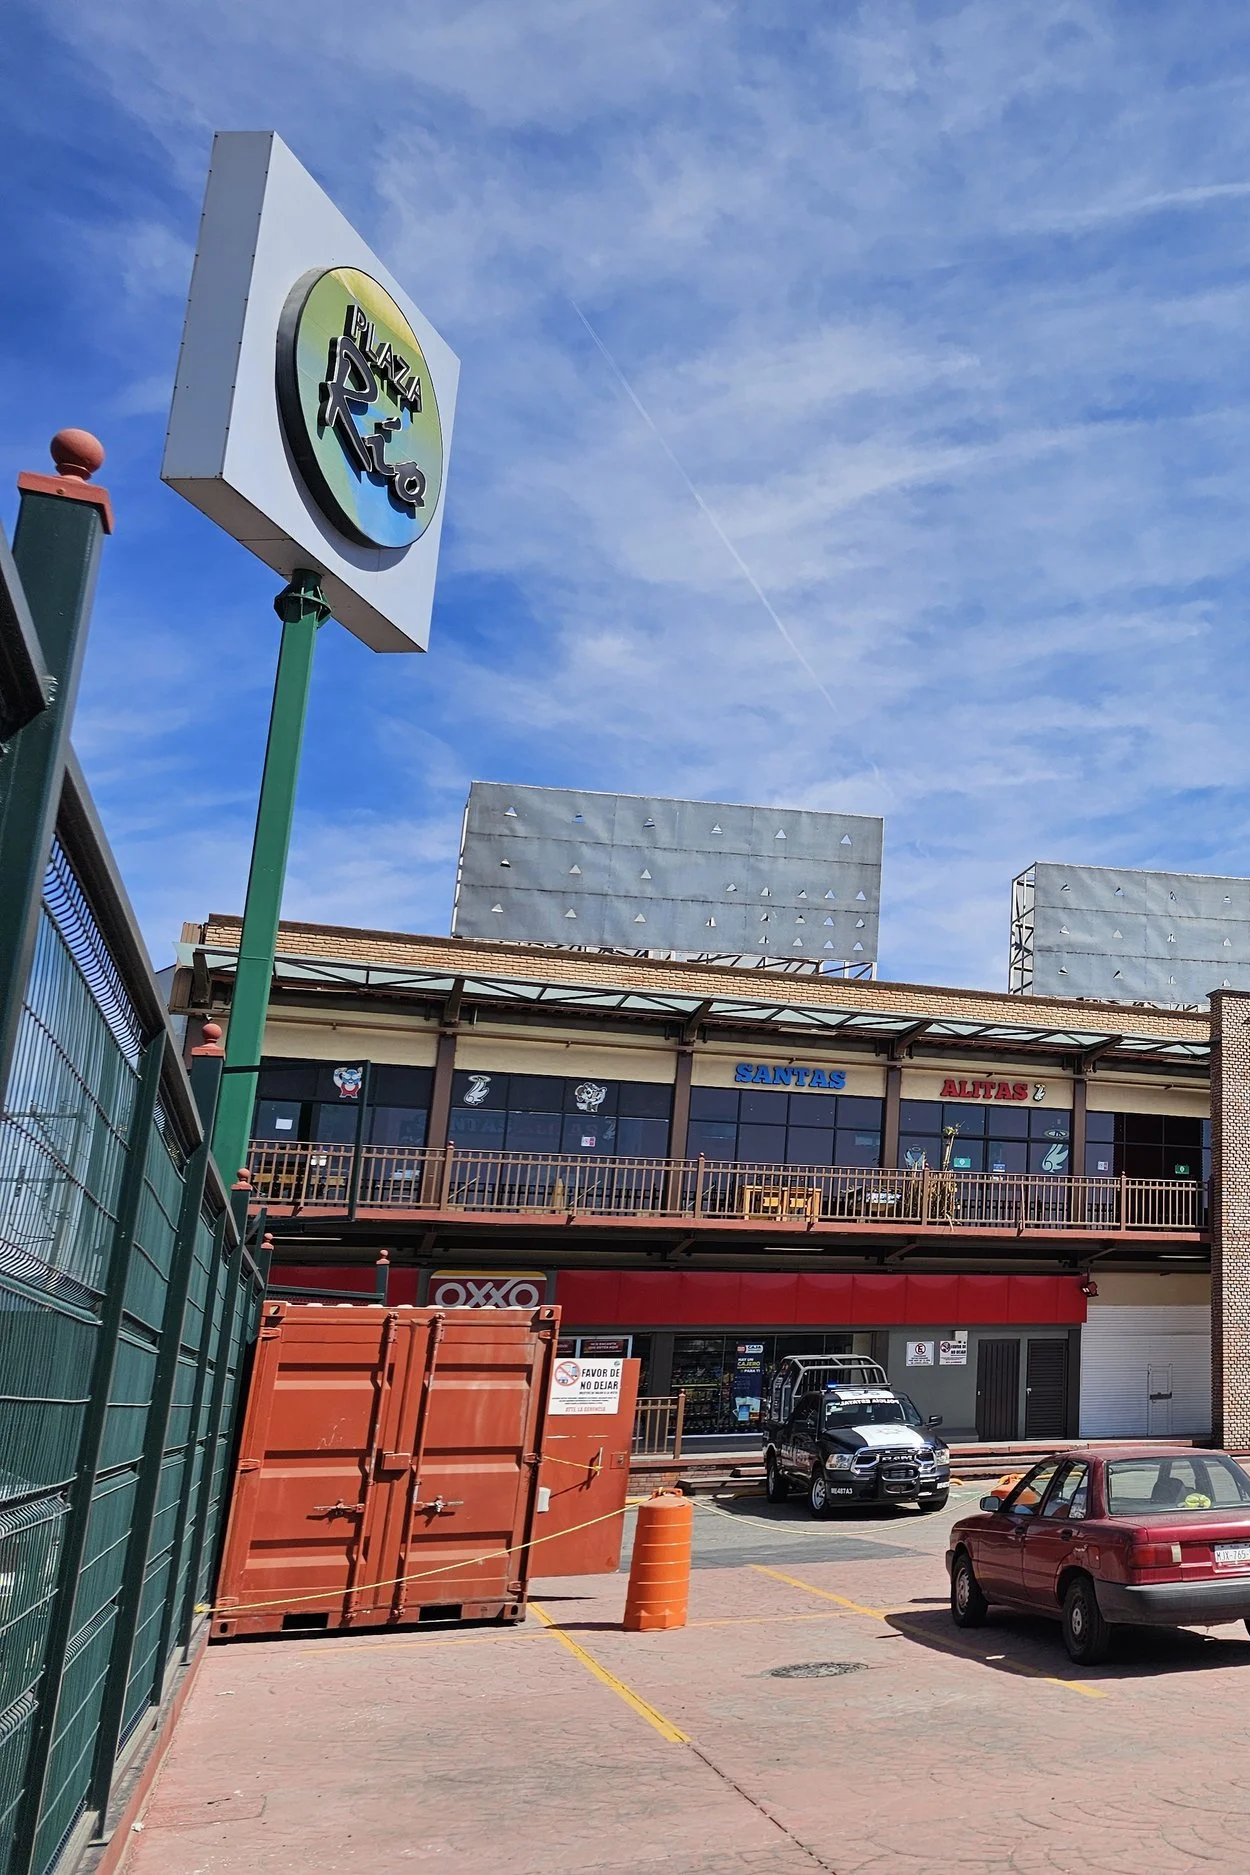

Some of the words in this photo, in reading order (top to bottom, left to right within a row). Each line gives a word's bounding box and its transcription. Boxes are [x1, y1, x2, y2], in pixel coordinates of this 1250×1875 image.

[343, 304, 423, 413] PLAZA
[735, 1063, 846, 1089] SANTAS
[940, 1079, 1028, 1101] ALITAS
[435, 1279, 539, 1308] OXXO
[581, 1368, 608, 1377] FAVOR
[609, 1368, 620, 1377] DE
[580, 1381, 592, 1390] NO
[594, 1381, 619, 1390] DEJAR
